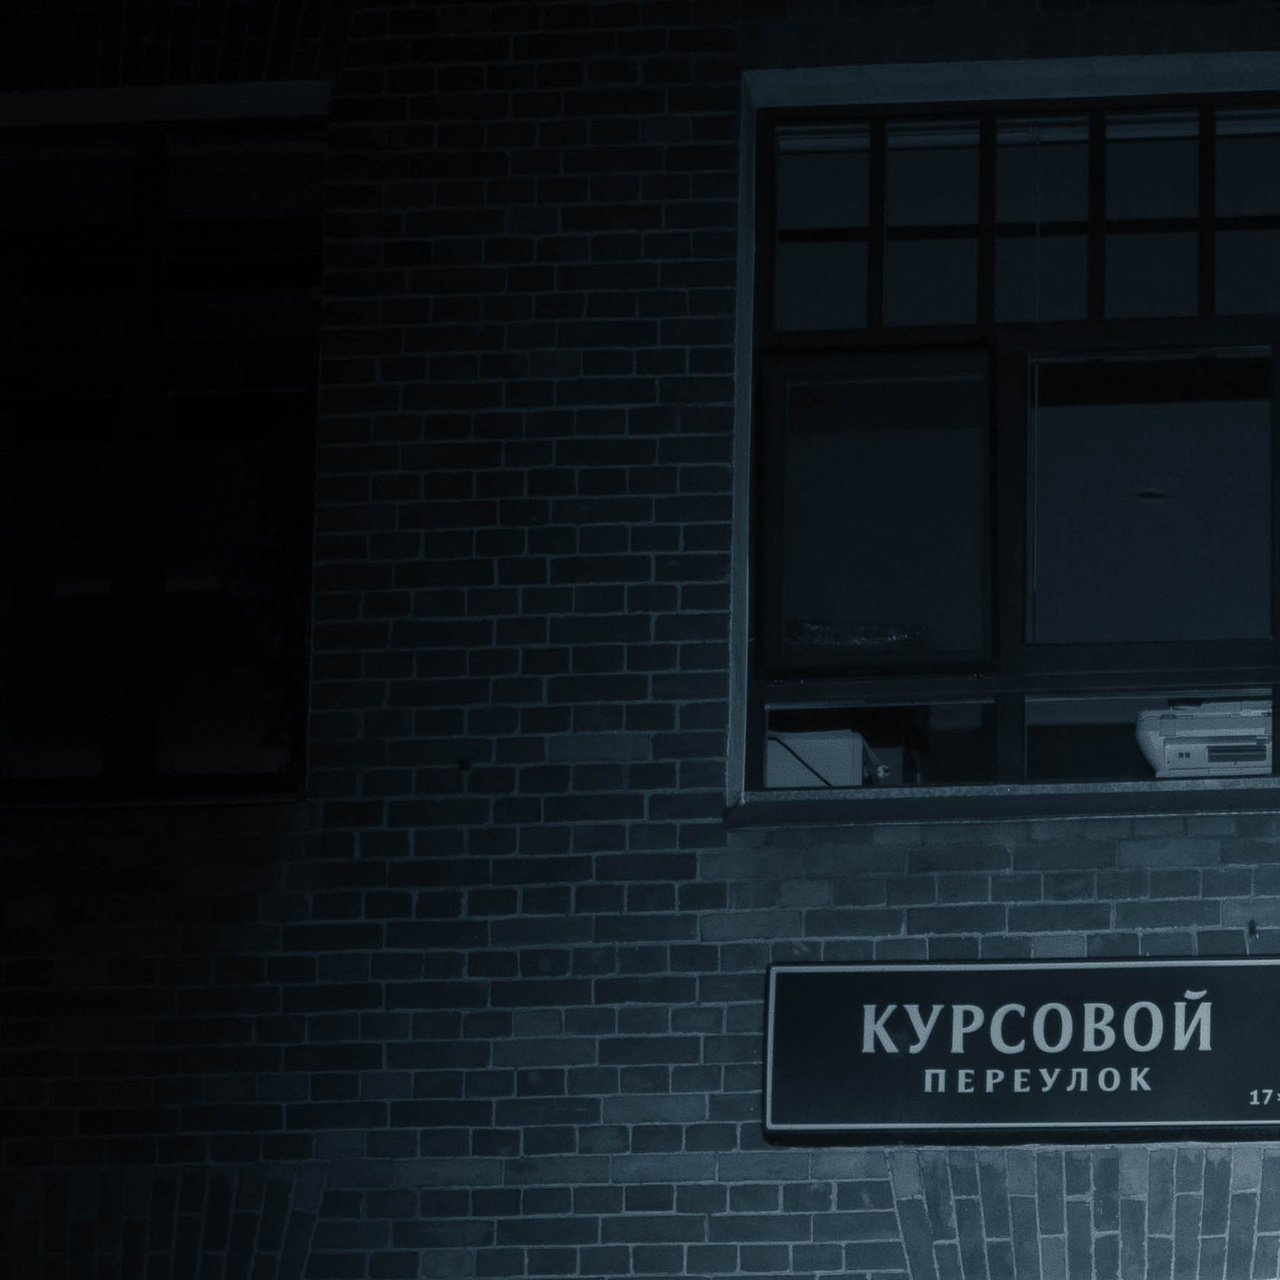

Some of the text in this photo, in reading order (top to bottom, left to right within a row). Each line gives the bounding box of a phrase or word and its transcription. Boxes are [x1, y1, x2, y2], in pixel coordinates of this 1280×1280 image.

[861, 988, 1213, 1055] КУРСОВОЙ
[924, 1067, 1152, 1093] ПЕРЕУЛОК
[1249, 1088, 1273, 1106] 17
